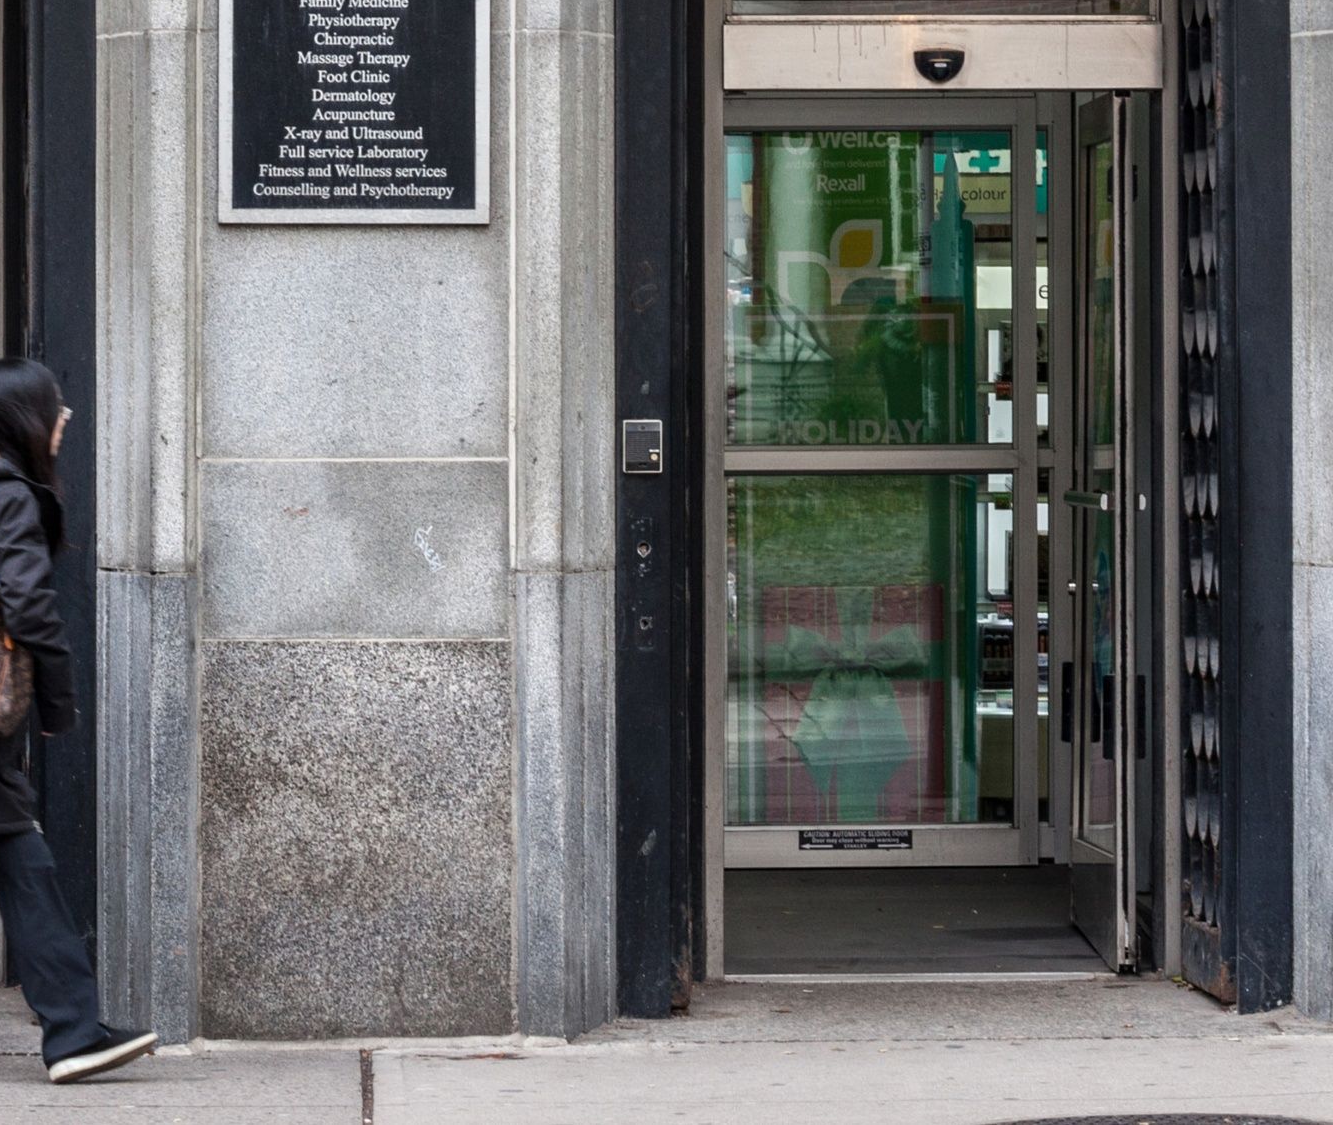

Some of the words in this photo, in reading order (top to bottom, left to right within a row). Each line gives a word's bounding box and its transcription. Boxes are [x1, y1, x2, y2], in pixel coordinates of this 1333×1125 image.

[308, 13, 400, 30] Physiotherapy
[313, 31, 394, 48] Chiropractic
[297, 50, 354, 68] Massage
[356, 50, 411, 68] Therapy
[317, 69, 348, 83] Foot
[350, 69, 391, 84] Clinic
[311, 88, 396, 105] Dermatology
[312, 107, 396, 124] Acupuncture
[284, 126, 323, 143] X-ray
[324, 126, 350, 140] and
[352, 126, 424, 140] Ultrasound
[279, 144, 305, 159] Full
[308, 145, 355, 159] service
[357, 145, 429, 162] Laboratory
[259, 163, 305, 177] Fitness
[307, 163, 332, 178] and
[334, 163, 393, 178] Wellness
[395, 164, 448, 178] services
[252, 182, 331, 200] Counselling
[333, 182, 358, 196] and
[360, 183, 455, 200] Psychotherapy
[817, 174, 866, 194] Rexall
[961, 188, 1007, 201] colour
